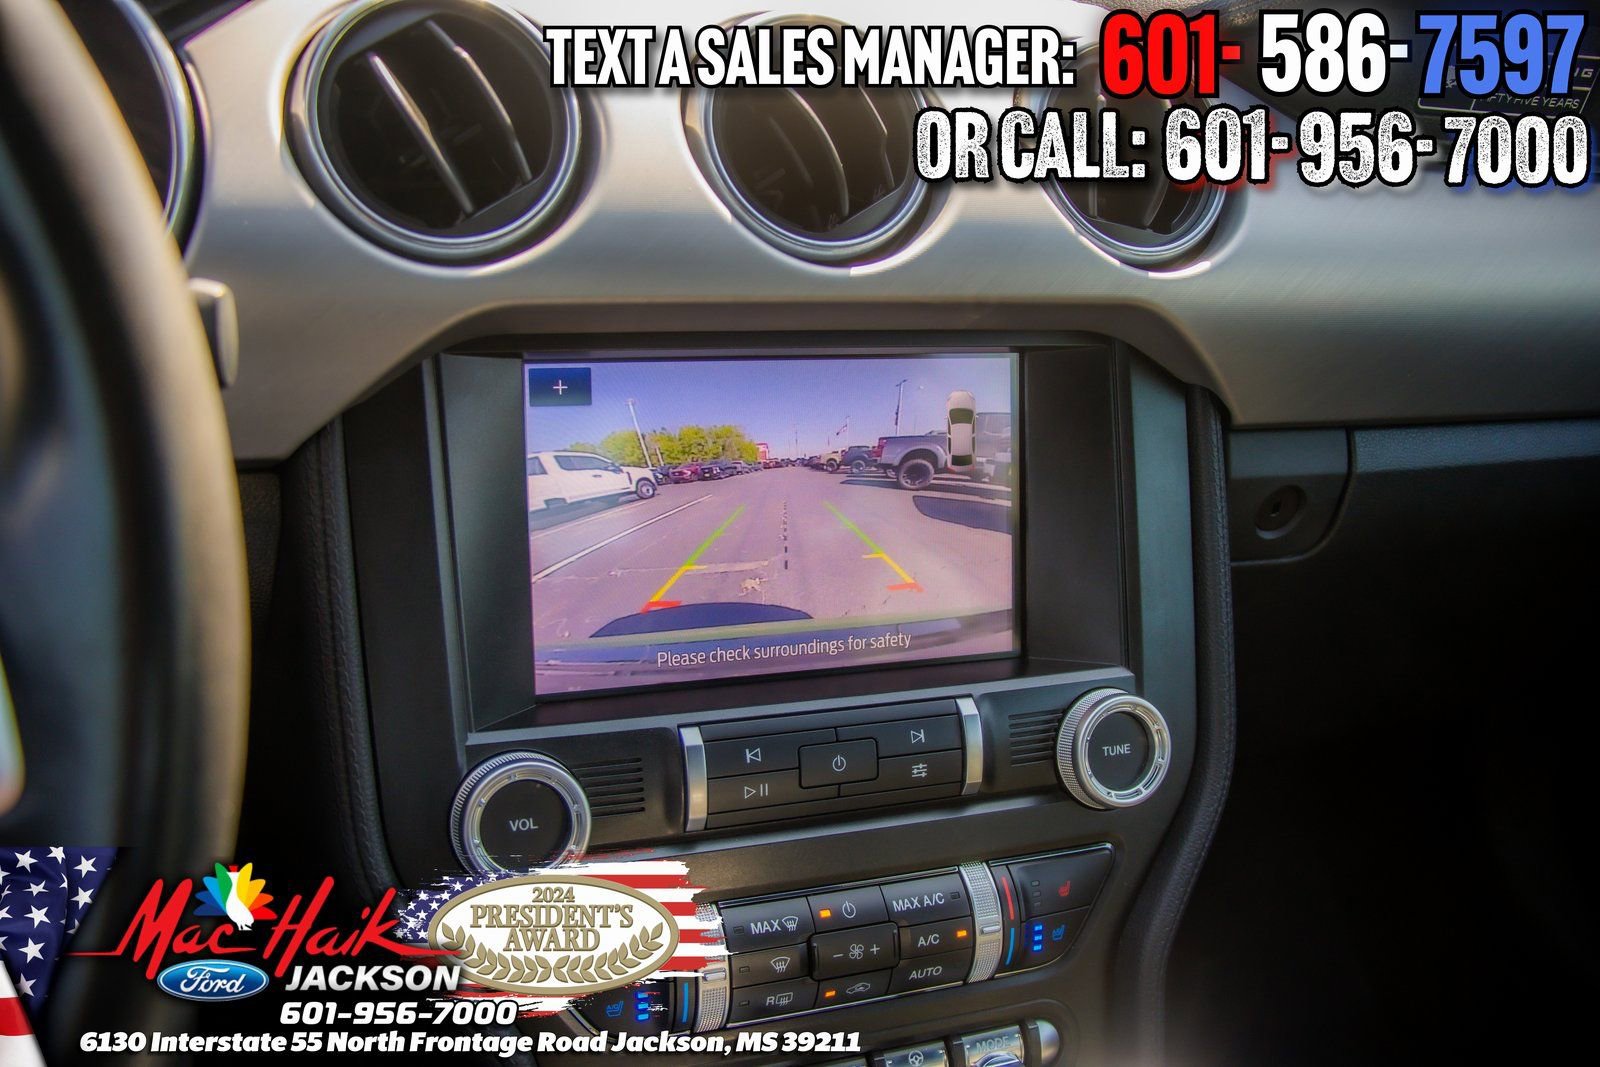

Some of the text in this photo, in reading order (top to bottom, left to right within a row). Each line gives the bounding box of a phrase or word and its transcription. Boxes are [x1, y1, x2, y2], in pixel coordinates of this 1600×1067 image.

[1542, 97, 1580, 109] YEARS
[657, 632, 911, 668] Please check surroundings for safety
[1102, 743, 1131, 756] TUNE
[509, 818, 538, 832] VOL
[892, 892, 945, 913] MAX A/C
[751, 919, 782, 935] MAX
[917, 933, 940, 948] A/C
[908, 965, 943, 980] AUTO
[976, 1036, 1010, 1051] MODE
